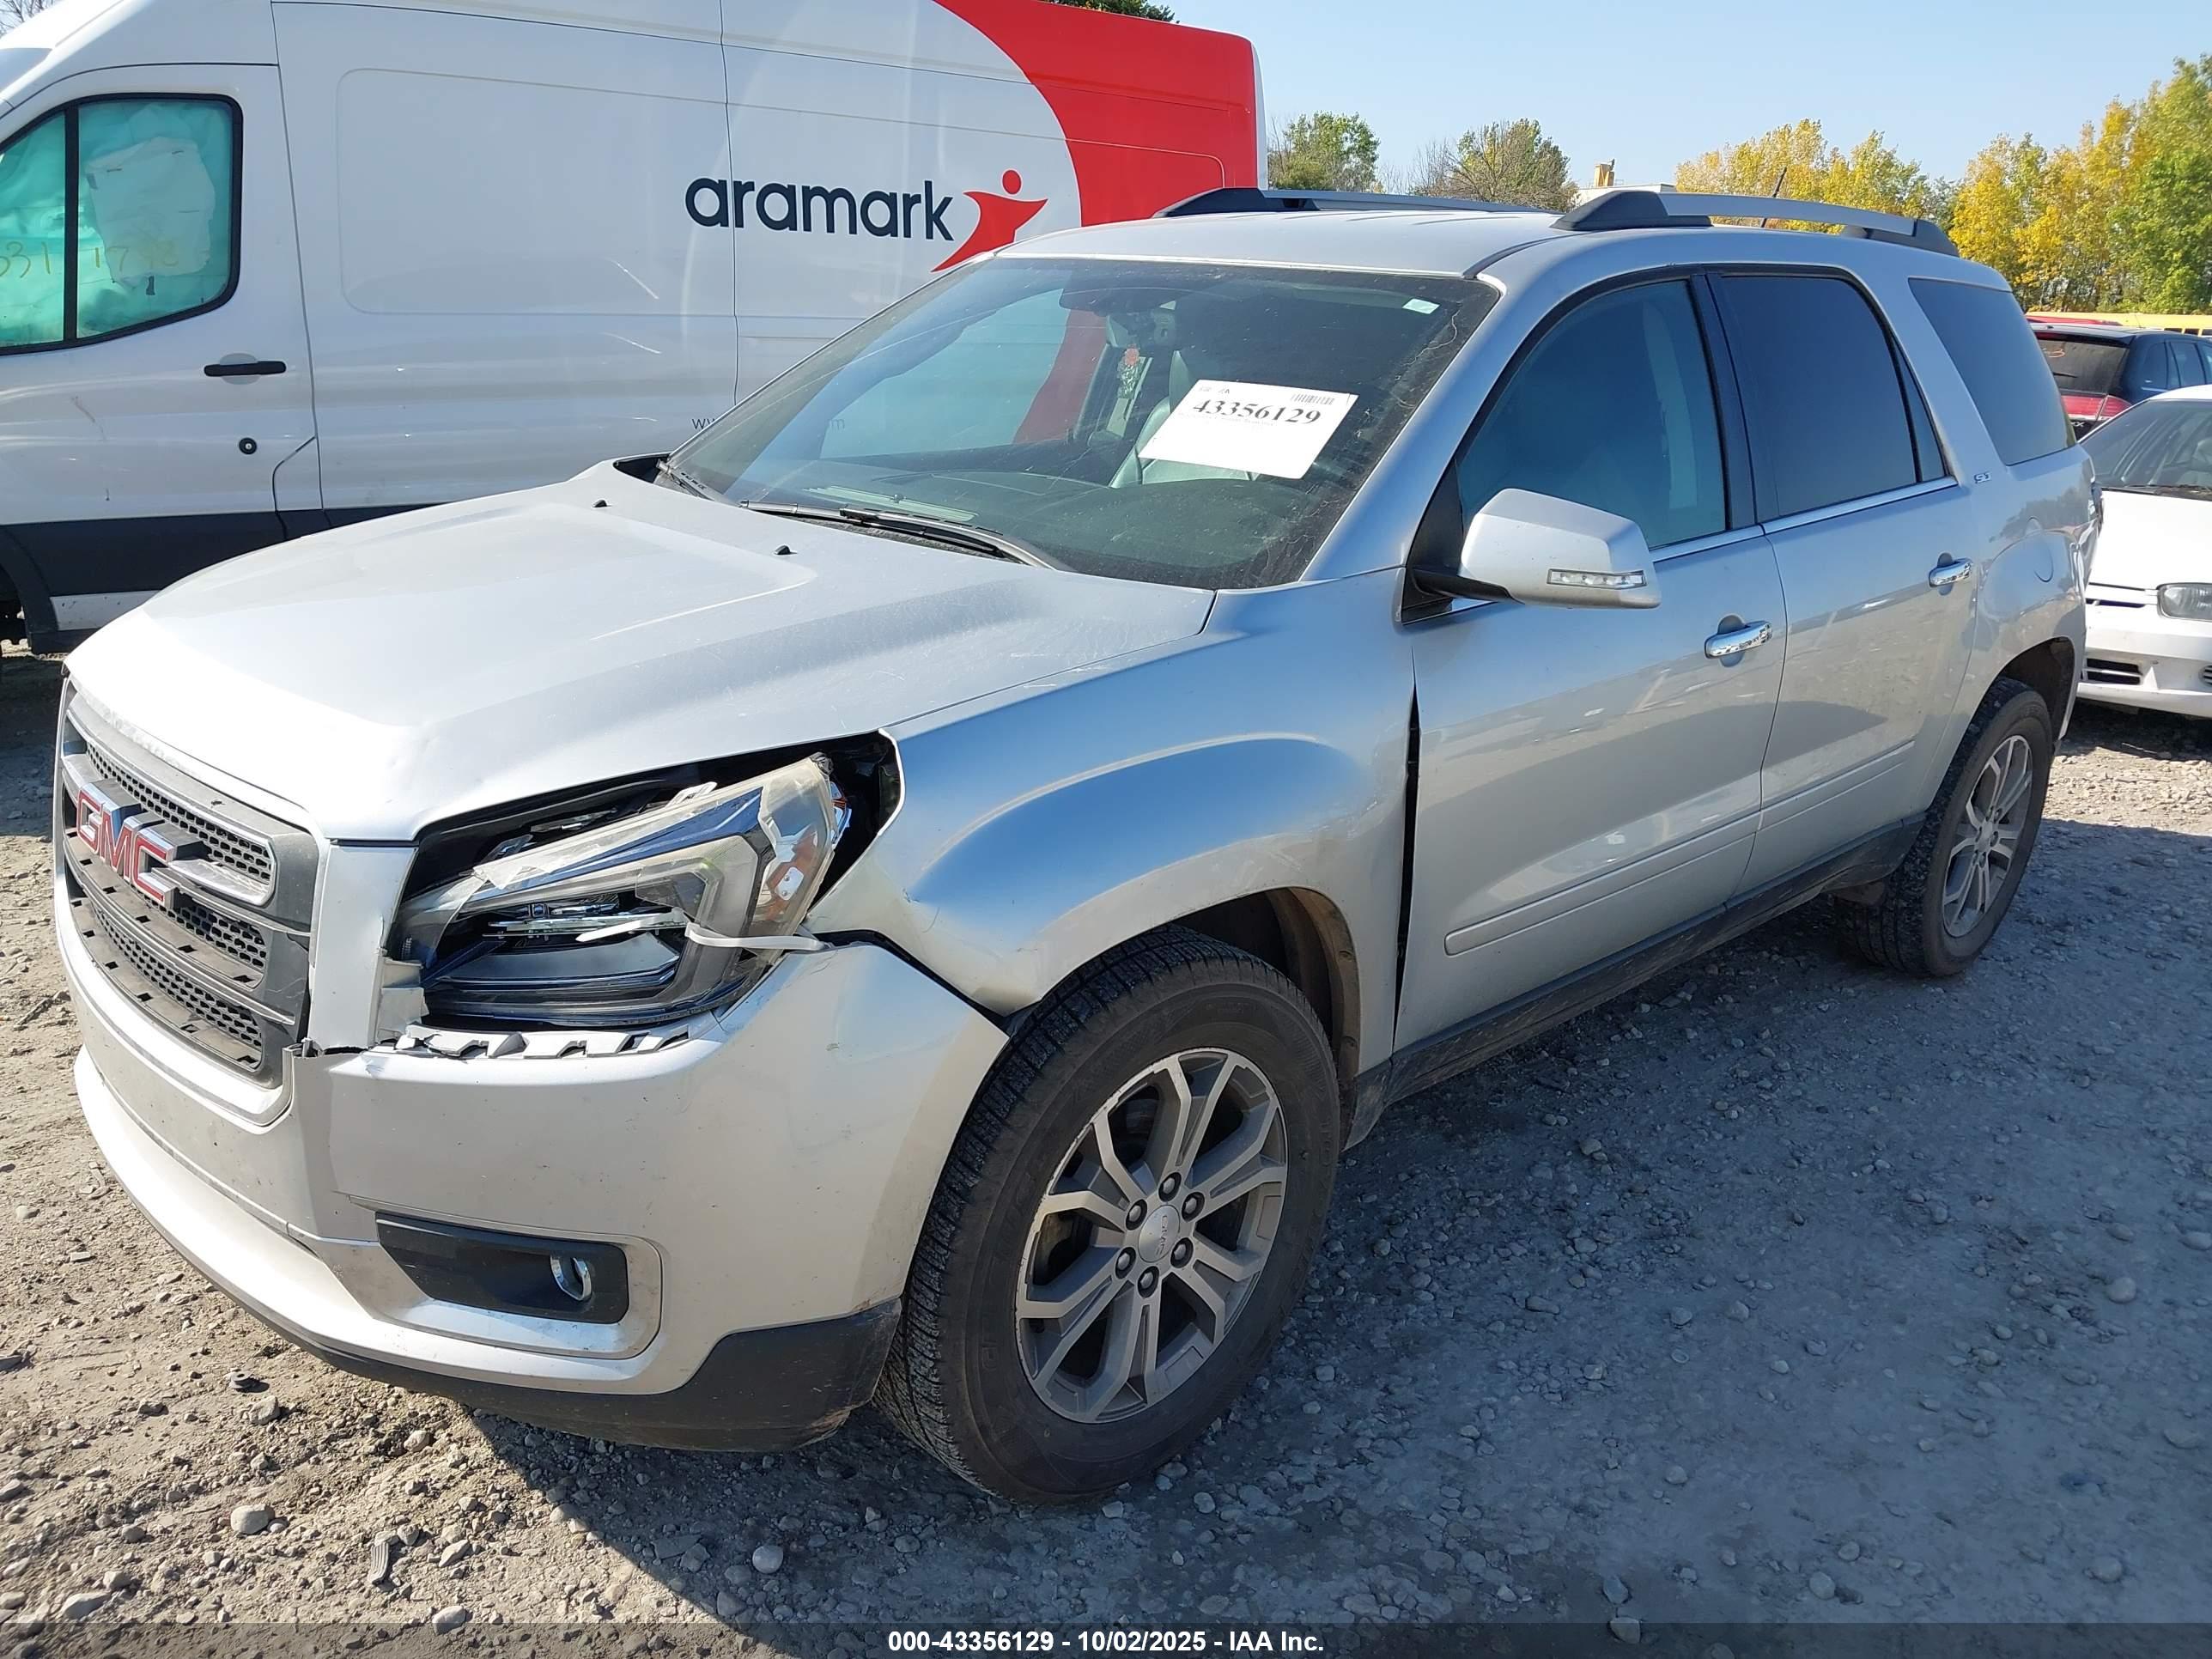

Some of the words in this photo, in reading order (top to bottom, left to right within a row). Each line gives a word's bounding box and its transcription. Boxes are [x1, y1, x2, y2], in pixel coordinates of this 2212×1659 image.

[685, 178, 954, 241] aramark
[1193, 399, 1321, 424] 43356129
[76, 788, 174, 907] GMC
